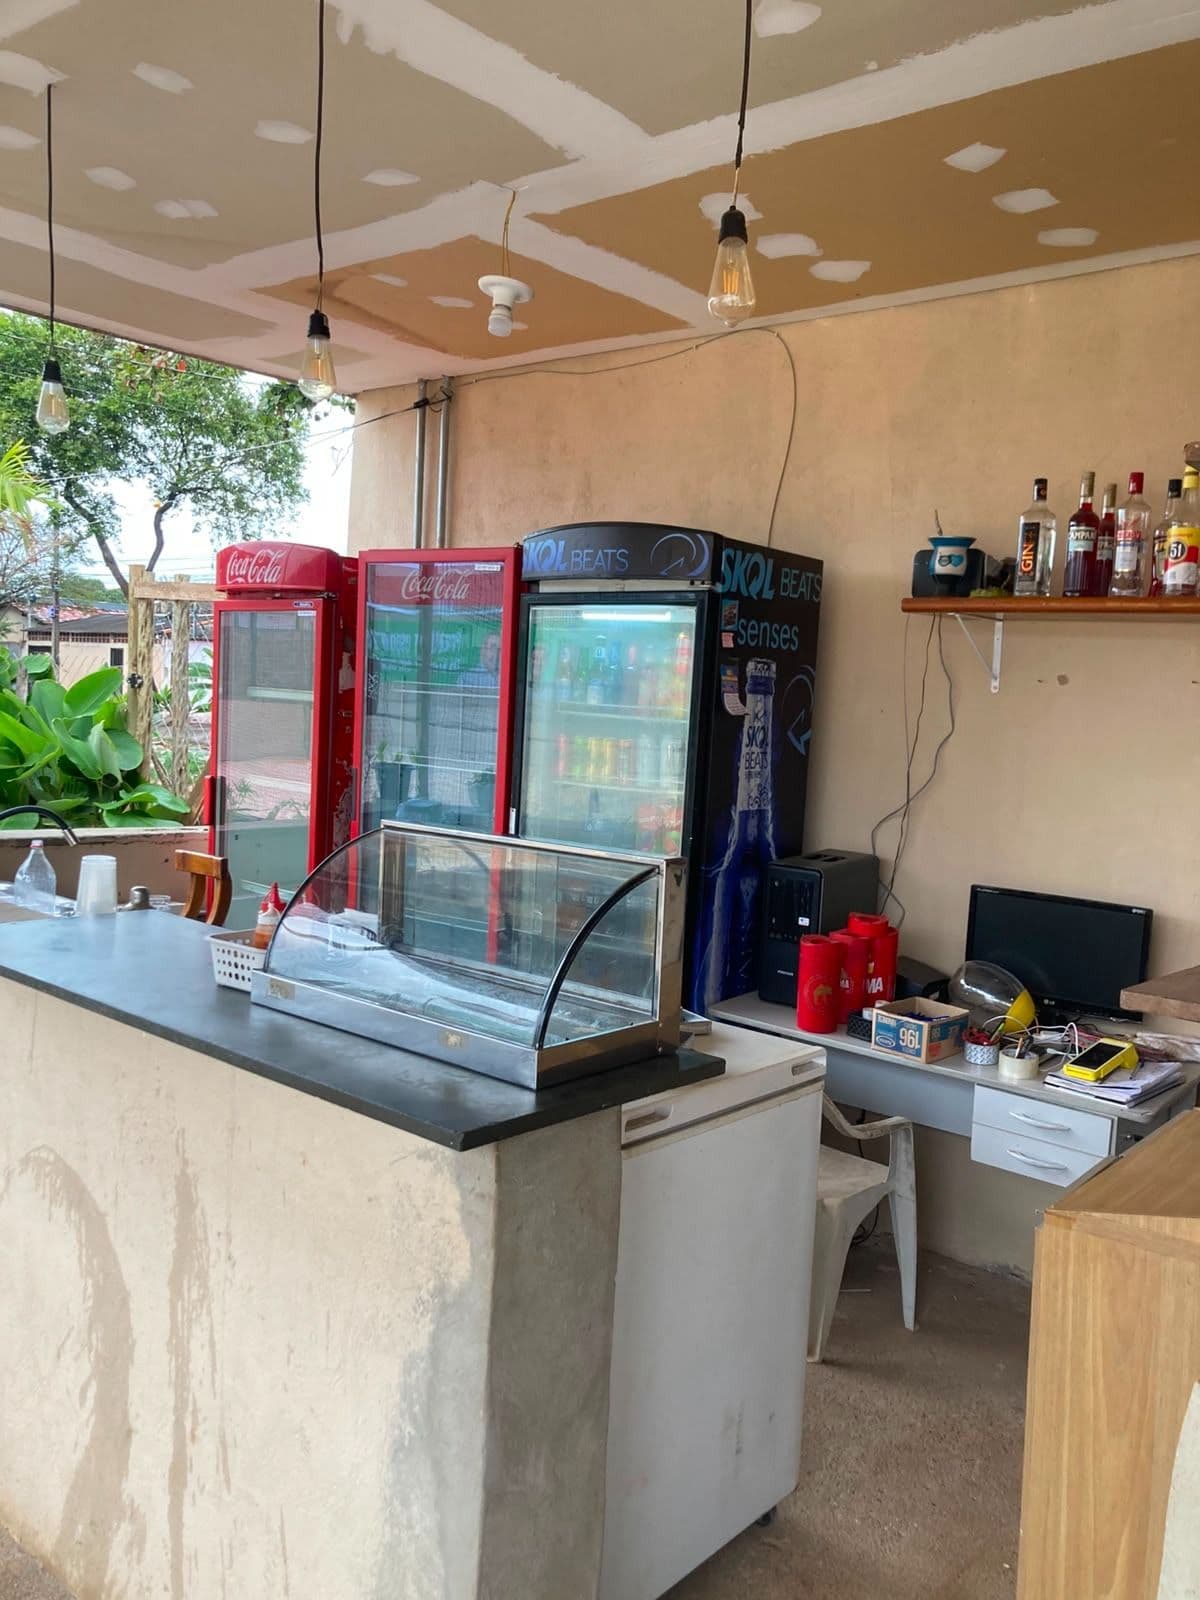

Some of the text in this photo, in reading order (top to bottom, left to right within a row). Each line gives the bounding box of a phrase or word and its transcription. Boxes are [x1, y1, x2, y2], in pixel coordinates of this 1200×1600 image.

[571, 549, 629, 573] BEATS
[1020, 543, 1034, 572] GIN
[1169, 543, 1183, 558] 51
[712, 547, 823, 603] SKOL BEATS
[737, 617, 799, 651] senses
[744, 751, 768, 770] BEATS
